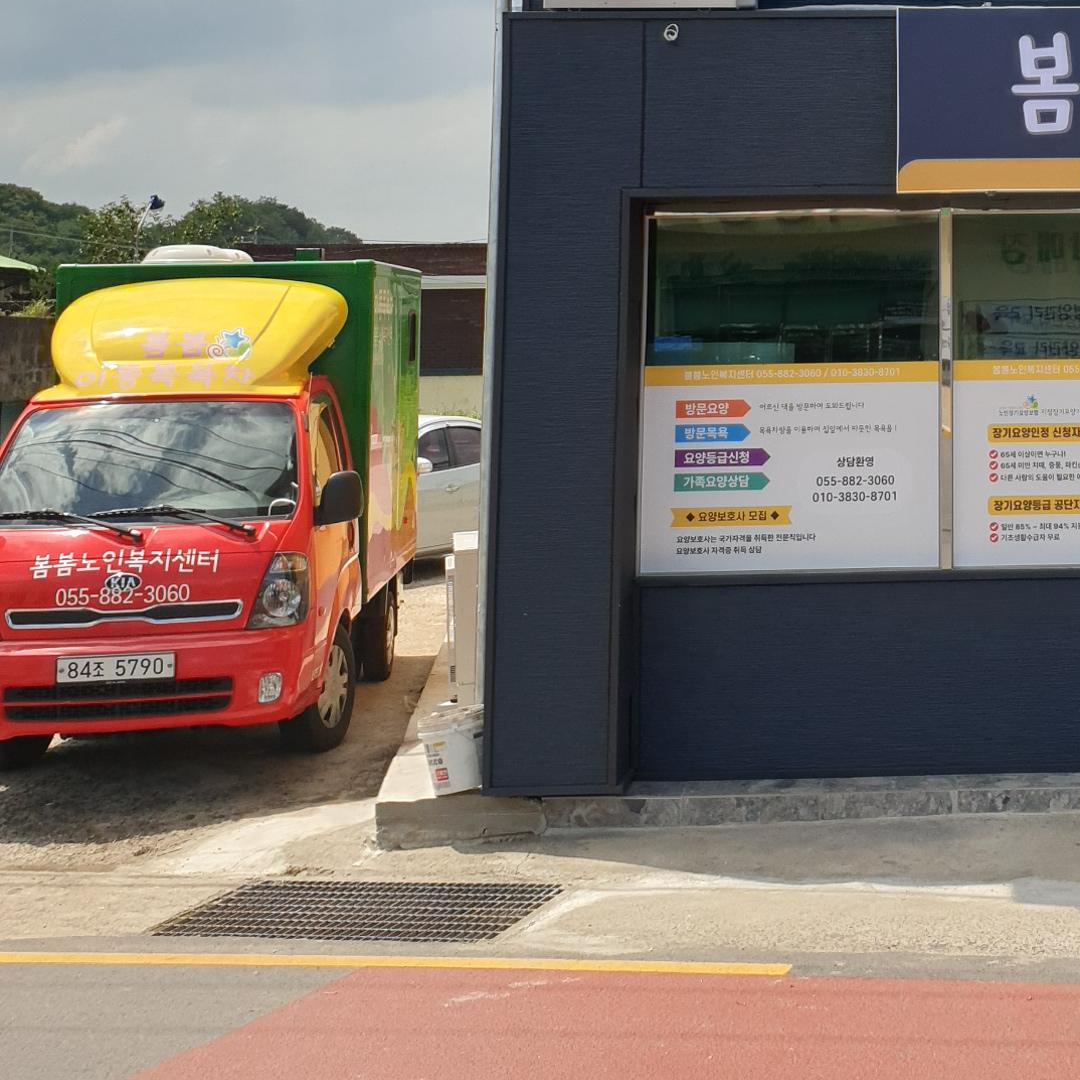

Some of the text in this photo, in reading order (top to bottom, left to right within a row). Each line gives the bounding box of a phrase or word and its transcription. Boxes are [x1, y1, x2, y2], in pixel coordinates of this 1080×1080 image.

[757, 368, 821, 378] 055-882-3060
[830, 367, 900, 377] 010-3830-8701
[685, 402, 729, 416] 방문요양
[684, 426, 728, 439] 방문목욕
[992, 427, 1050, 438] 장기요양인정
[684, 451, 750, 464] 요양등급신청
[836, 456, 875, 467] 상담환영
[683, 475, 749, 488] 가족요양상담
[816, 475, 895, 487] 055-882-3060
[812, 491, 897, 503] 010-3830-8701
[994, 500, 1051, 511] 장기요양등급
[698, 510, 767, 522] 요양보호사 모집
[676, 535, 717, 544] 요양보호사는
[676, 547, 710, 555] 요양보호사
[30, 549, 220, 579] 봄봄노인복지센터
[110, 576, 136, 589] KIA
[56, 584, 191, 606] 055-882-3060
[67, 657, 164, 679] 84조 5790
